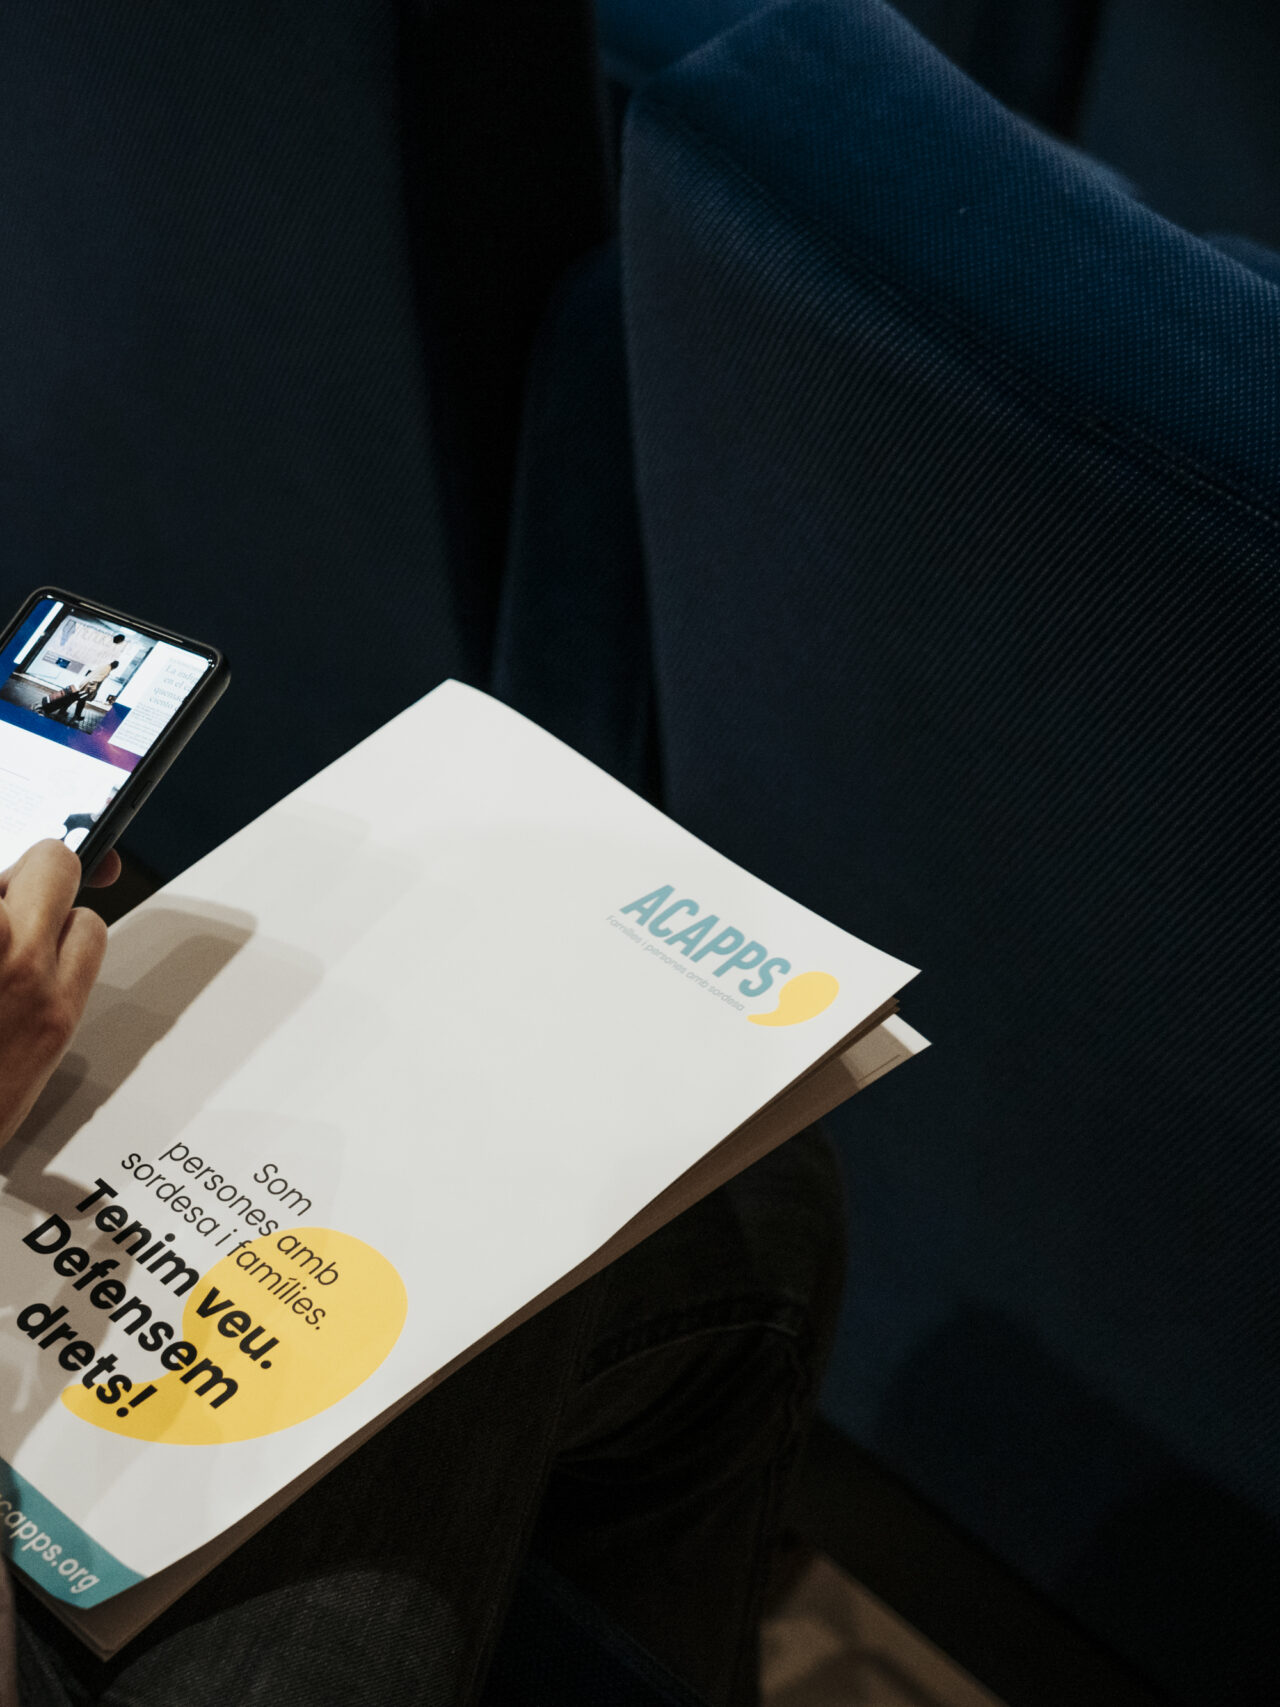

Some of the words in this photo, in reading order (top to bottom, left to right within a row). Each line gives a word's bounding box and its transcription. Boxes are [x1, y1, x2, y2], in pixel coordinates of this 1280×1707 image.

[619, 884, 791, 998] ACAPPS
[686, 971, 709, 989] amb
[708, 984, 746, 1012] sordesa
[121, 1152, 220, 1237] sordesa
[214, 1228, 238, 1247] i
[226, 1239, 328, 1331] famílies.
[158, 1141, 279, 1237] persones
[276, 1234, 340, 1287] amb
[253, 1163, 313, 1217] Som
[22, 1213, 239, 1411] Defensem
[75, 1177, 201, 1298] Tenim
[195, 1287, 280, 1370] veu.
[16, 1302, 158, 1418] drets!
